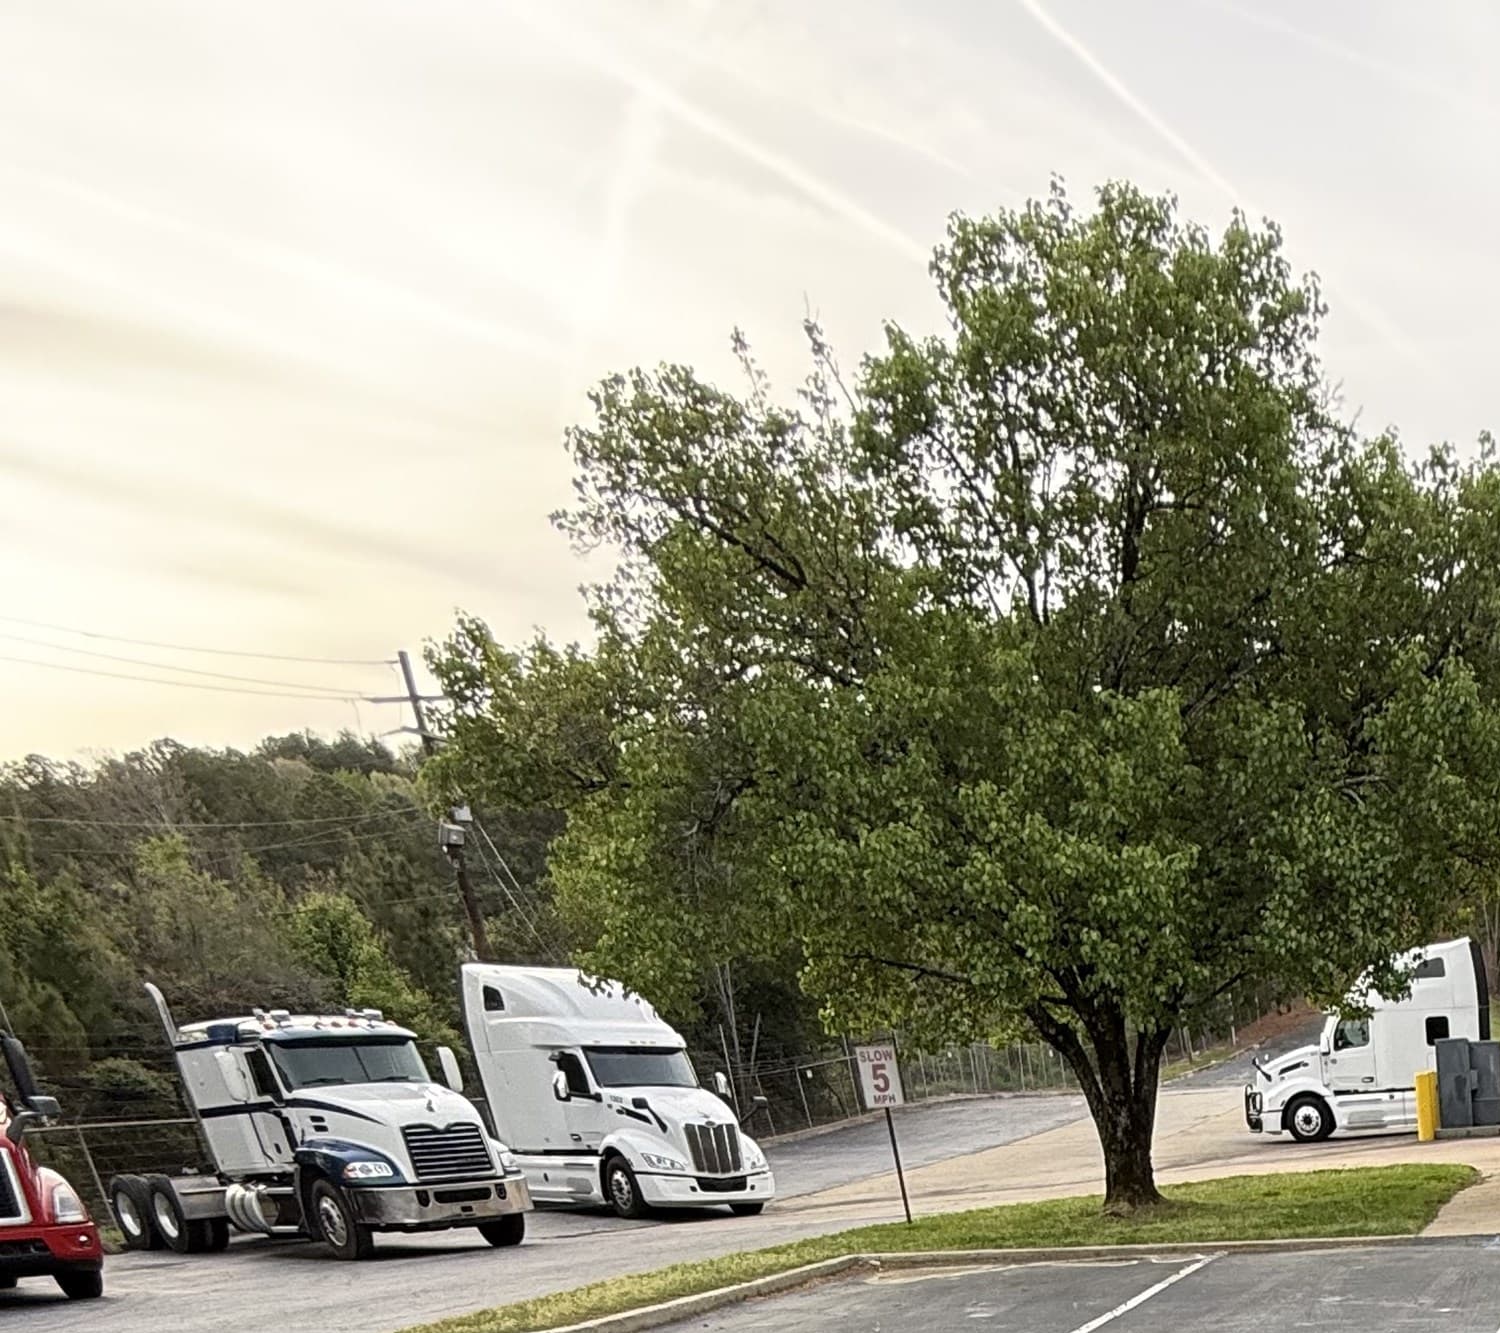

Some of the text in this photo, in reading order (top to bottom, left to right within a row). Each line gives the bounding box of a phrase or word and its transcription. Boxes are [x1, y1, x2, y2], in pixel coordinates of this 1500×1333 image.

[859, 1050, 893, 1063] SLOW
[871, 1064, 890, 1093] 5
[873, 1095, 896, 1105] MPH
